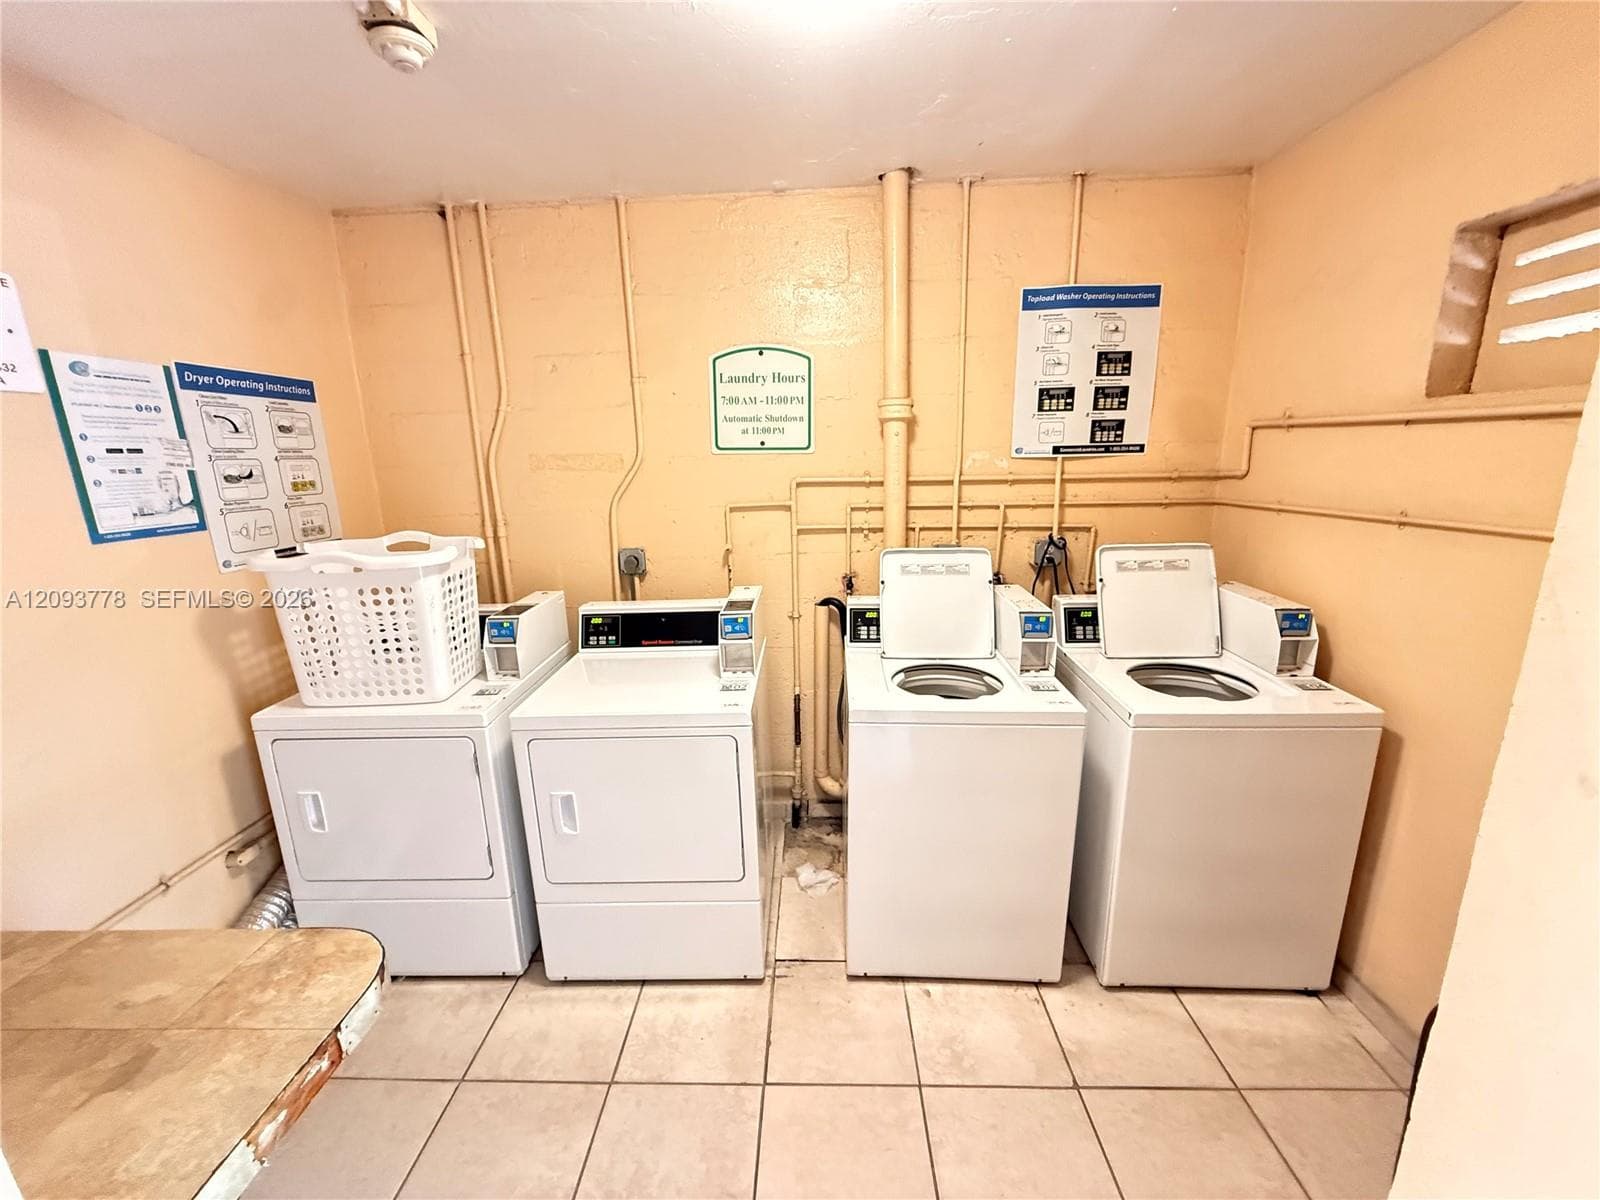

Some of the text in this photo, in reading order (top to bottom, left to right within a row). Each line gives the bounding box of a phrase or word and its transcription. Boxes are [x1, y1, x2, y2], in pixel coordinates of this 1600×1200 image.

[1027, 295, 1055, 303] Topload
[1056, 292, 1081, 300] Washer
[1082, 292, 1115, 301] Operating
[0, 362, 17, 373] 32
[184, 371, 311, 396] Dryer Operating Instructions
[720, 372, 806, 386] Laundry Hours
[721, 396, 739, 405] 7:00
[741, 396, 757, 405] AM
[766, 396, 788, 405] 11:00
[790, 396, 804, 405] PM
[722, 414, 804, 423] Automatic Shutdown
